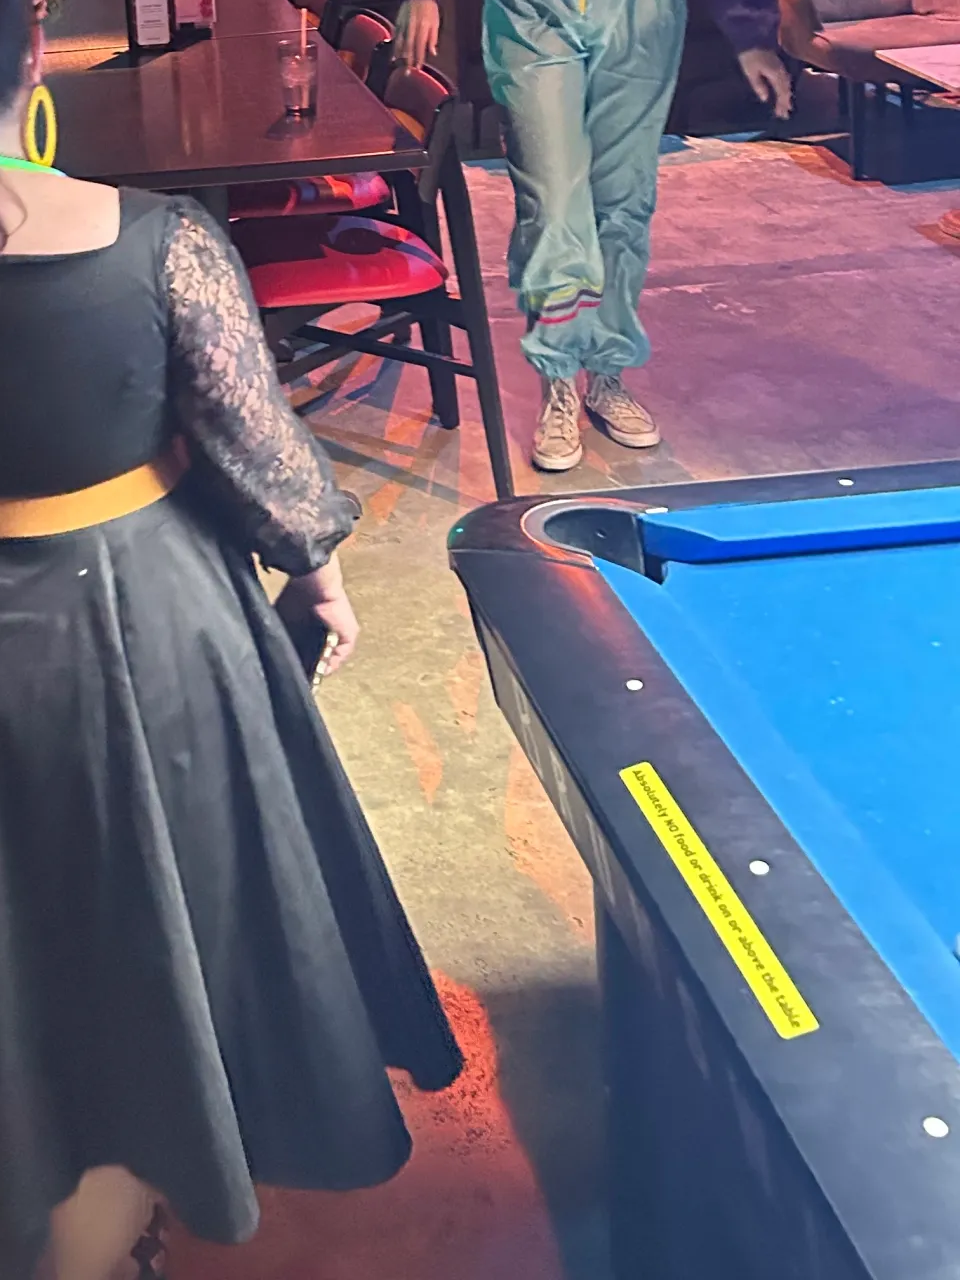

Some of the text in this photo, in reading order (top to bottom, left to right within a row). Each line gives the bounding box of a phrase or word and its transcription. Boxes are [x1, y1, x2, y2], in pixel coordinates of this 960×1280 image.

[633, 770, 801, 1028] Absolutely NO food or drink on or above the table
